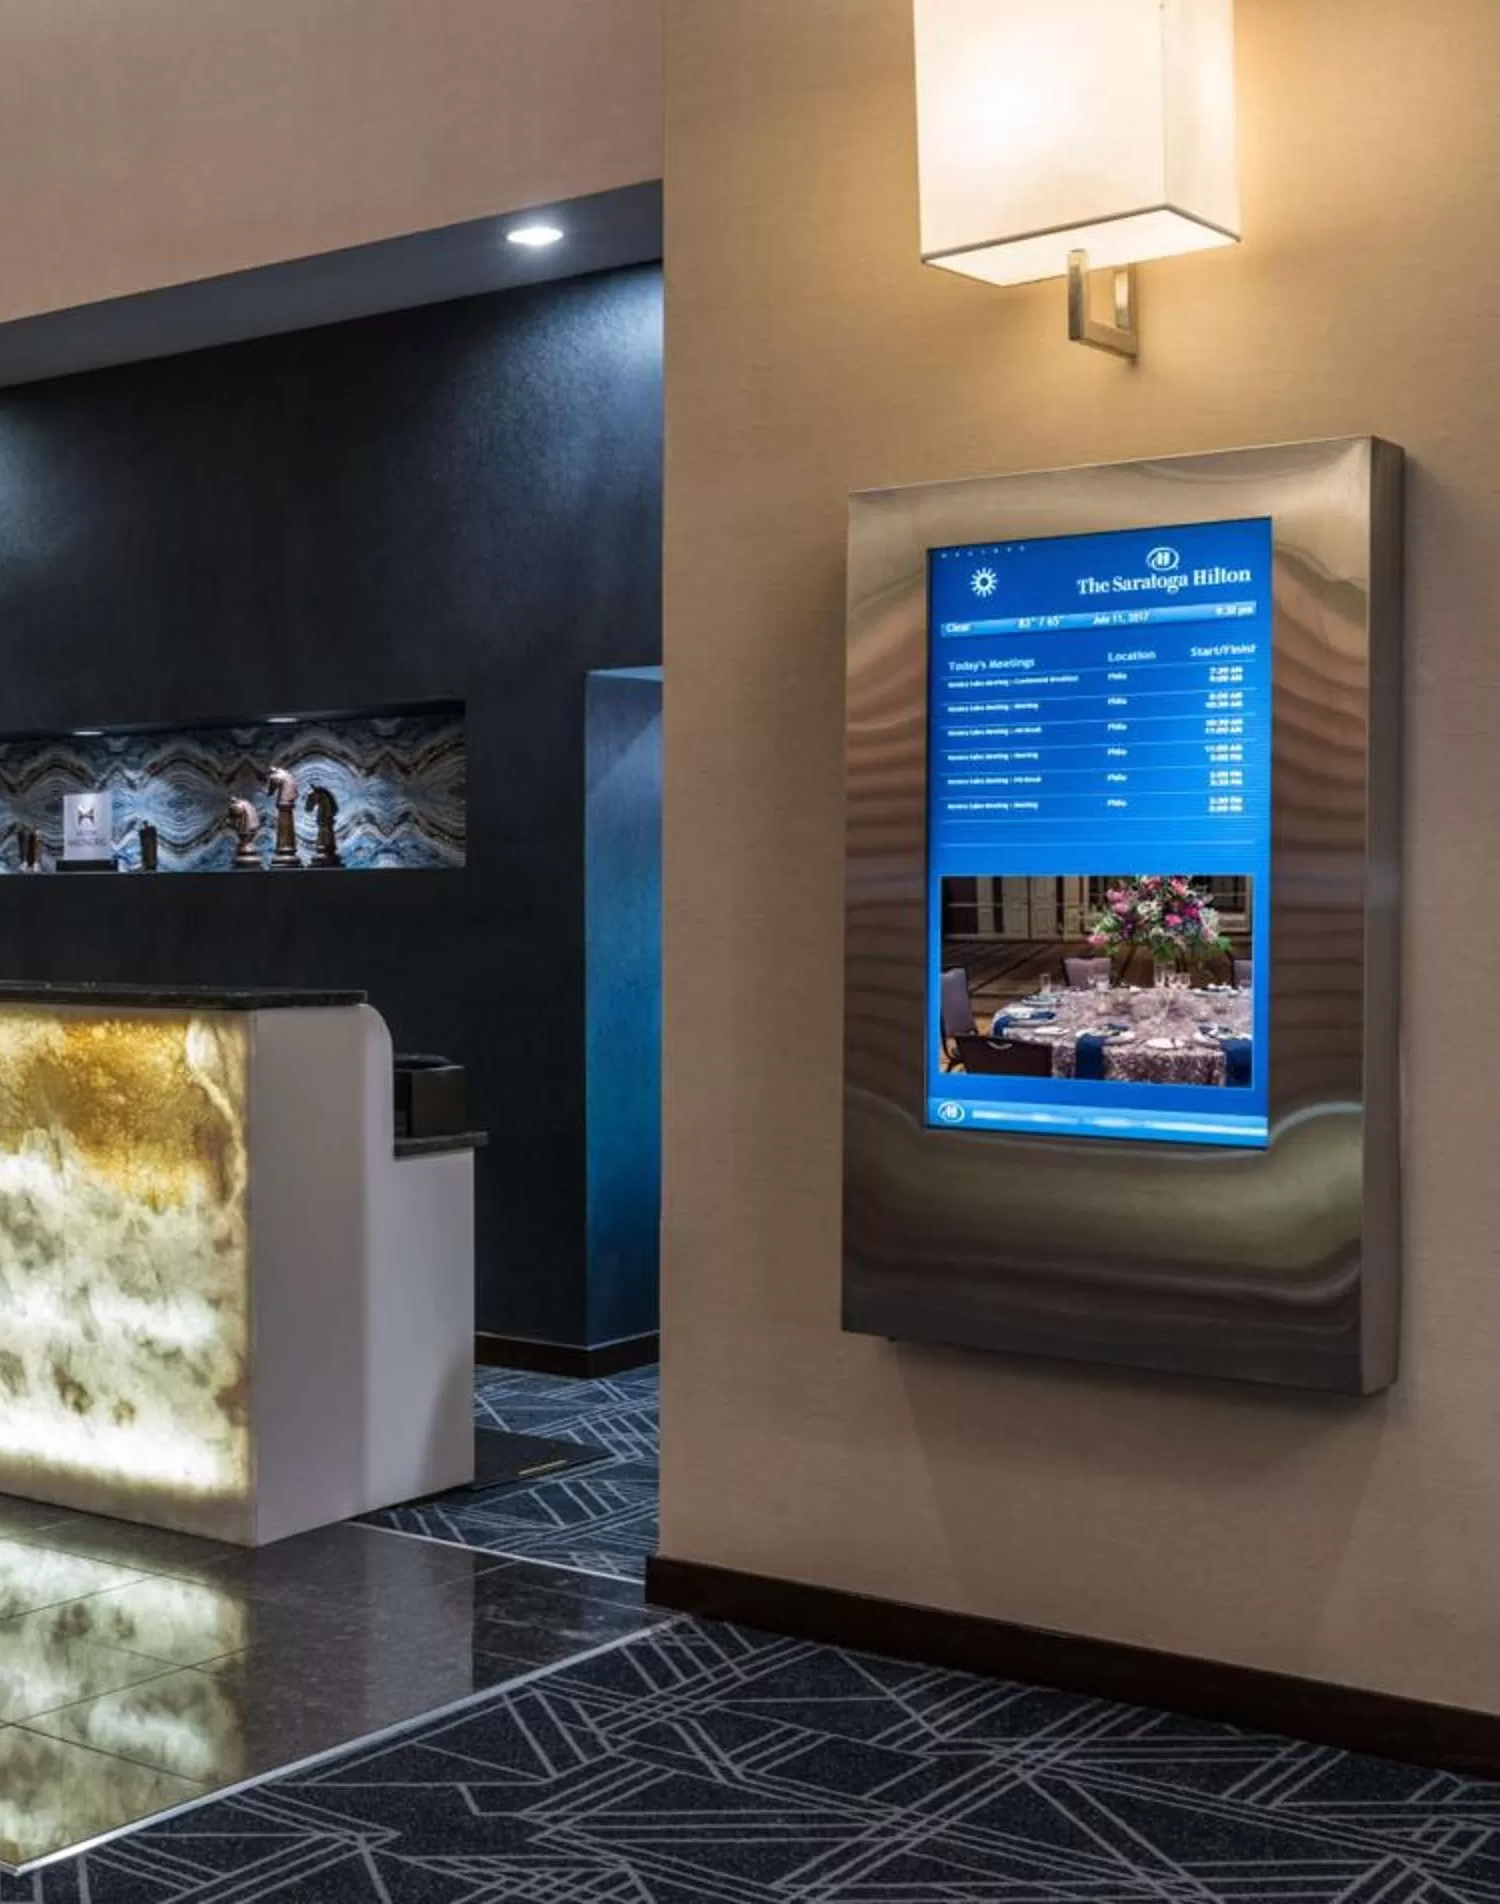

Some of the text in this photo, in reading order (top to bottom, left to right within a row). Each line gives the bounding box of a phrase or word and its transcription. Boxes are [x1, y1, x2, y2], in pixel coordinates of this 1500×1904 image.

[1077, 566, 1252, 595] The Saratoga Hilton
[1107, 650, 1156, 662] Location
[948, 657, 1036, 672] Today's Meetings
